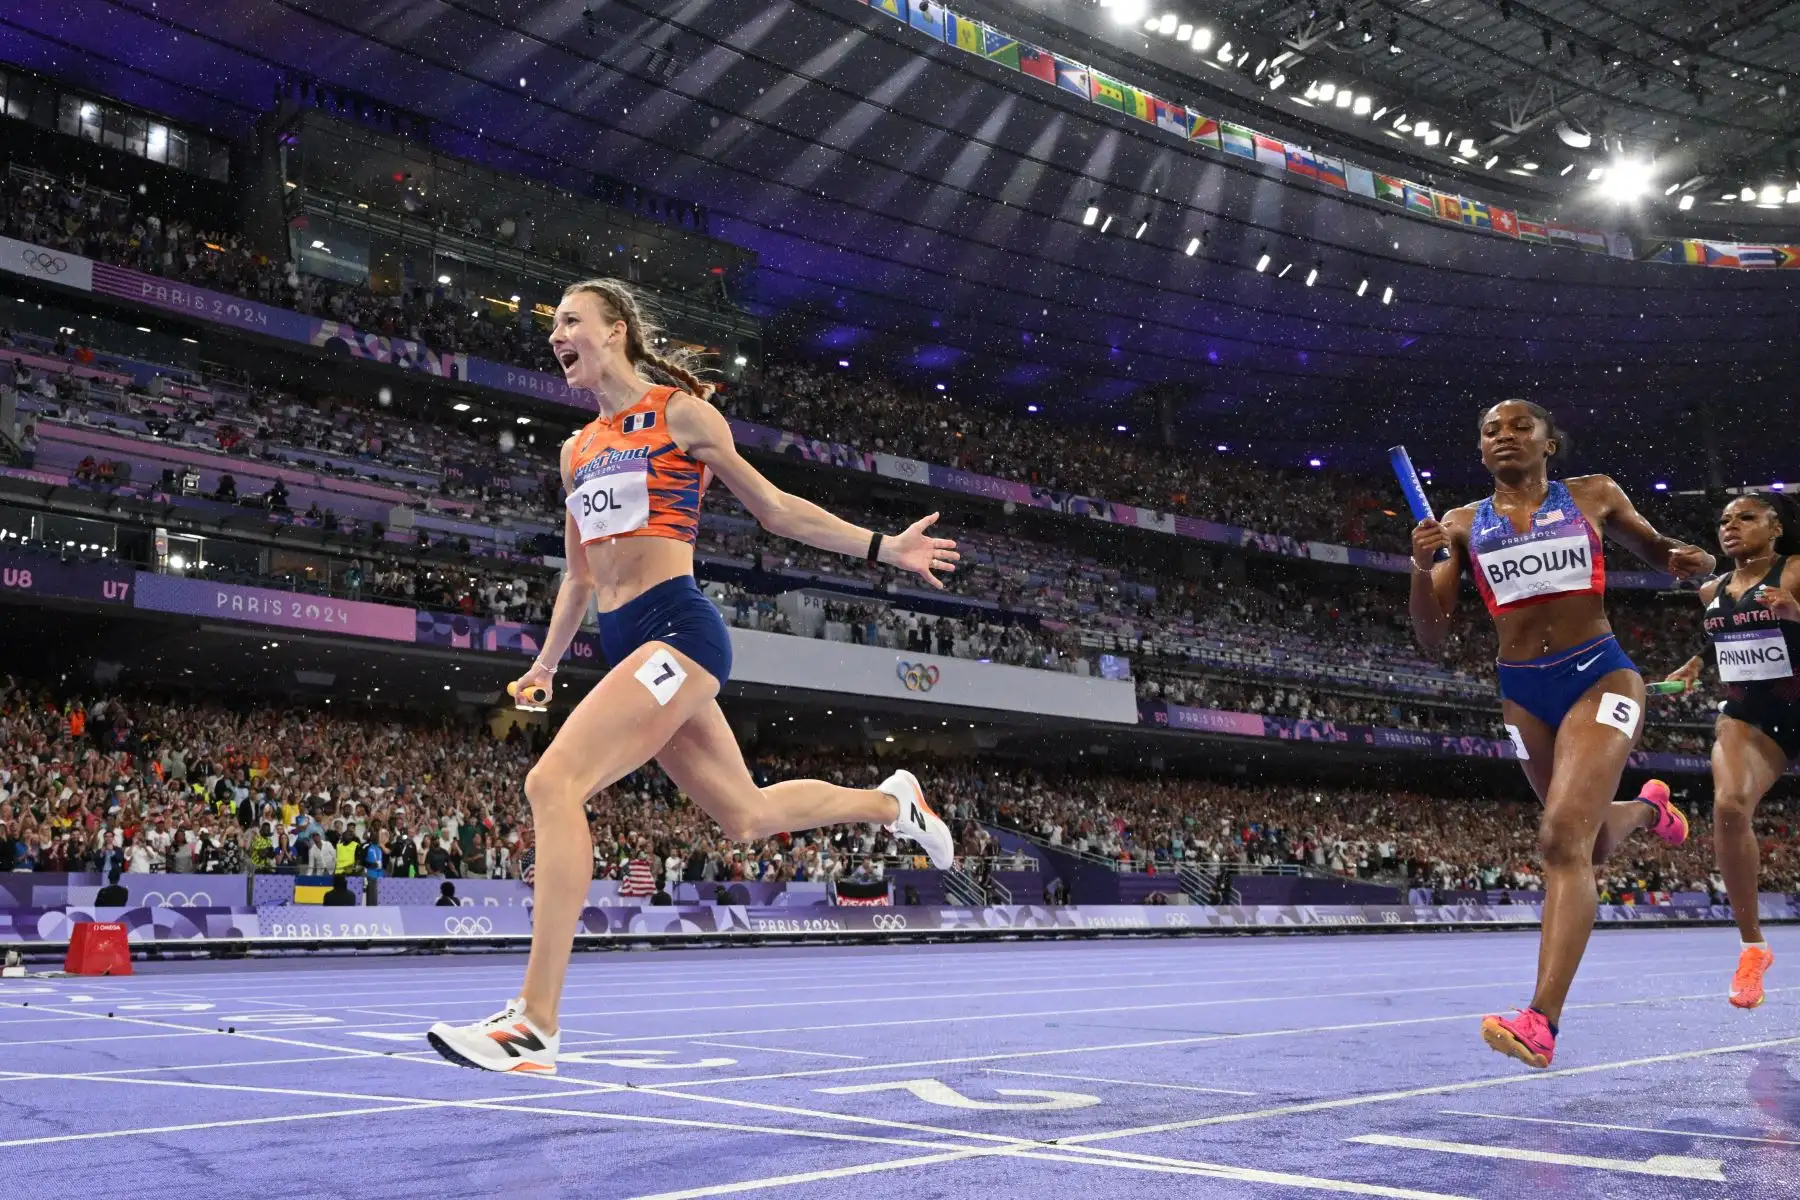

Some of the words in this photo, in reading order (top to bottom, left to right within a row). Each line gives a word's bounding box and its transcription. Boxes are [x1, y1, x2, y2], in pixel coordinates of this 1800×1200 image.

[142, 282, 205, 310] PARIS
[213, 300, 267, 326] 2024
[507, 372, 554, 394] PARIS
[560, 385, 592, 403] 202
[582, 487, 621, 516] BOL
[1501, 535, 1529, 546] PARIS
[1531, 530, 1556, 539] 2024
[1487, 547, 1587, 584] BROWN
[3, 568, 32, 588] U8
[103, 580, 129, 600] U7
[217, 592, 282, 616] PARIS
[292, 602, 347, 624] 2024
[574, 642, 593, 658] U6
[1719, 646, 1784, 666] ANNING
[653, 662, 676, 686] 7
[1179, 711, 1208, 722] PARIS
[1612, 701, 1631, 724] 5
[1385, 731, 1410, 743] PARIS
[272, 923, 333, 938] PARIS
[340, 923, 392, 938] 2024
[759, 919, 799, 932] PARIS
[804, 918, 840, 932] 2024
[809, 1078, 1101, 1111] 2
[1341, 1133, 1727, 1181] 1
